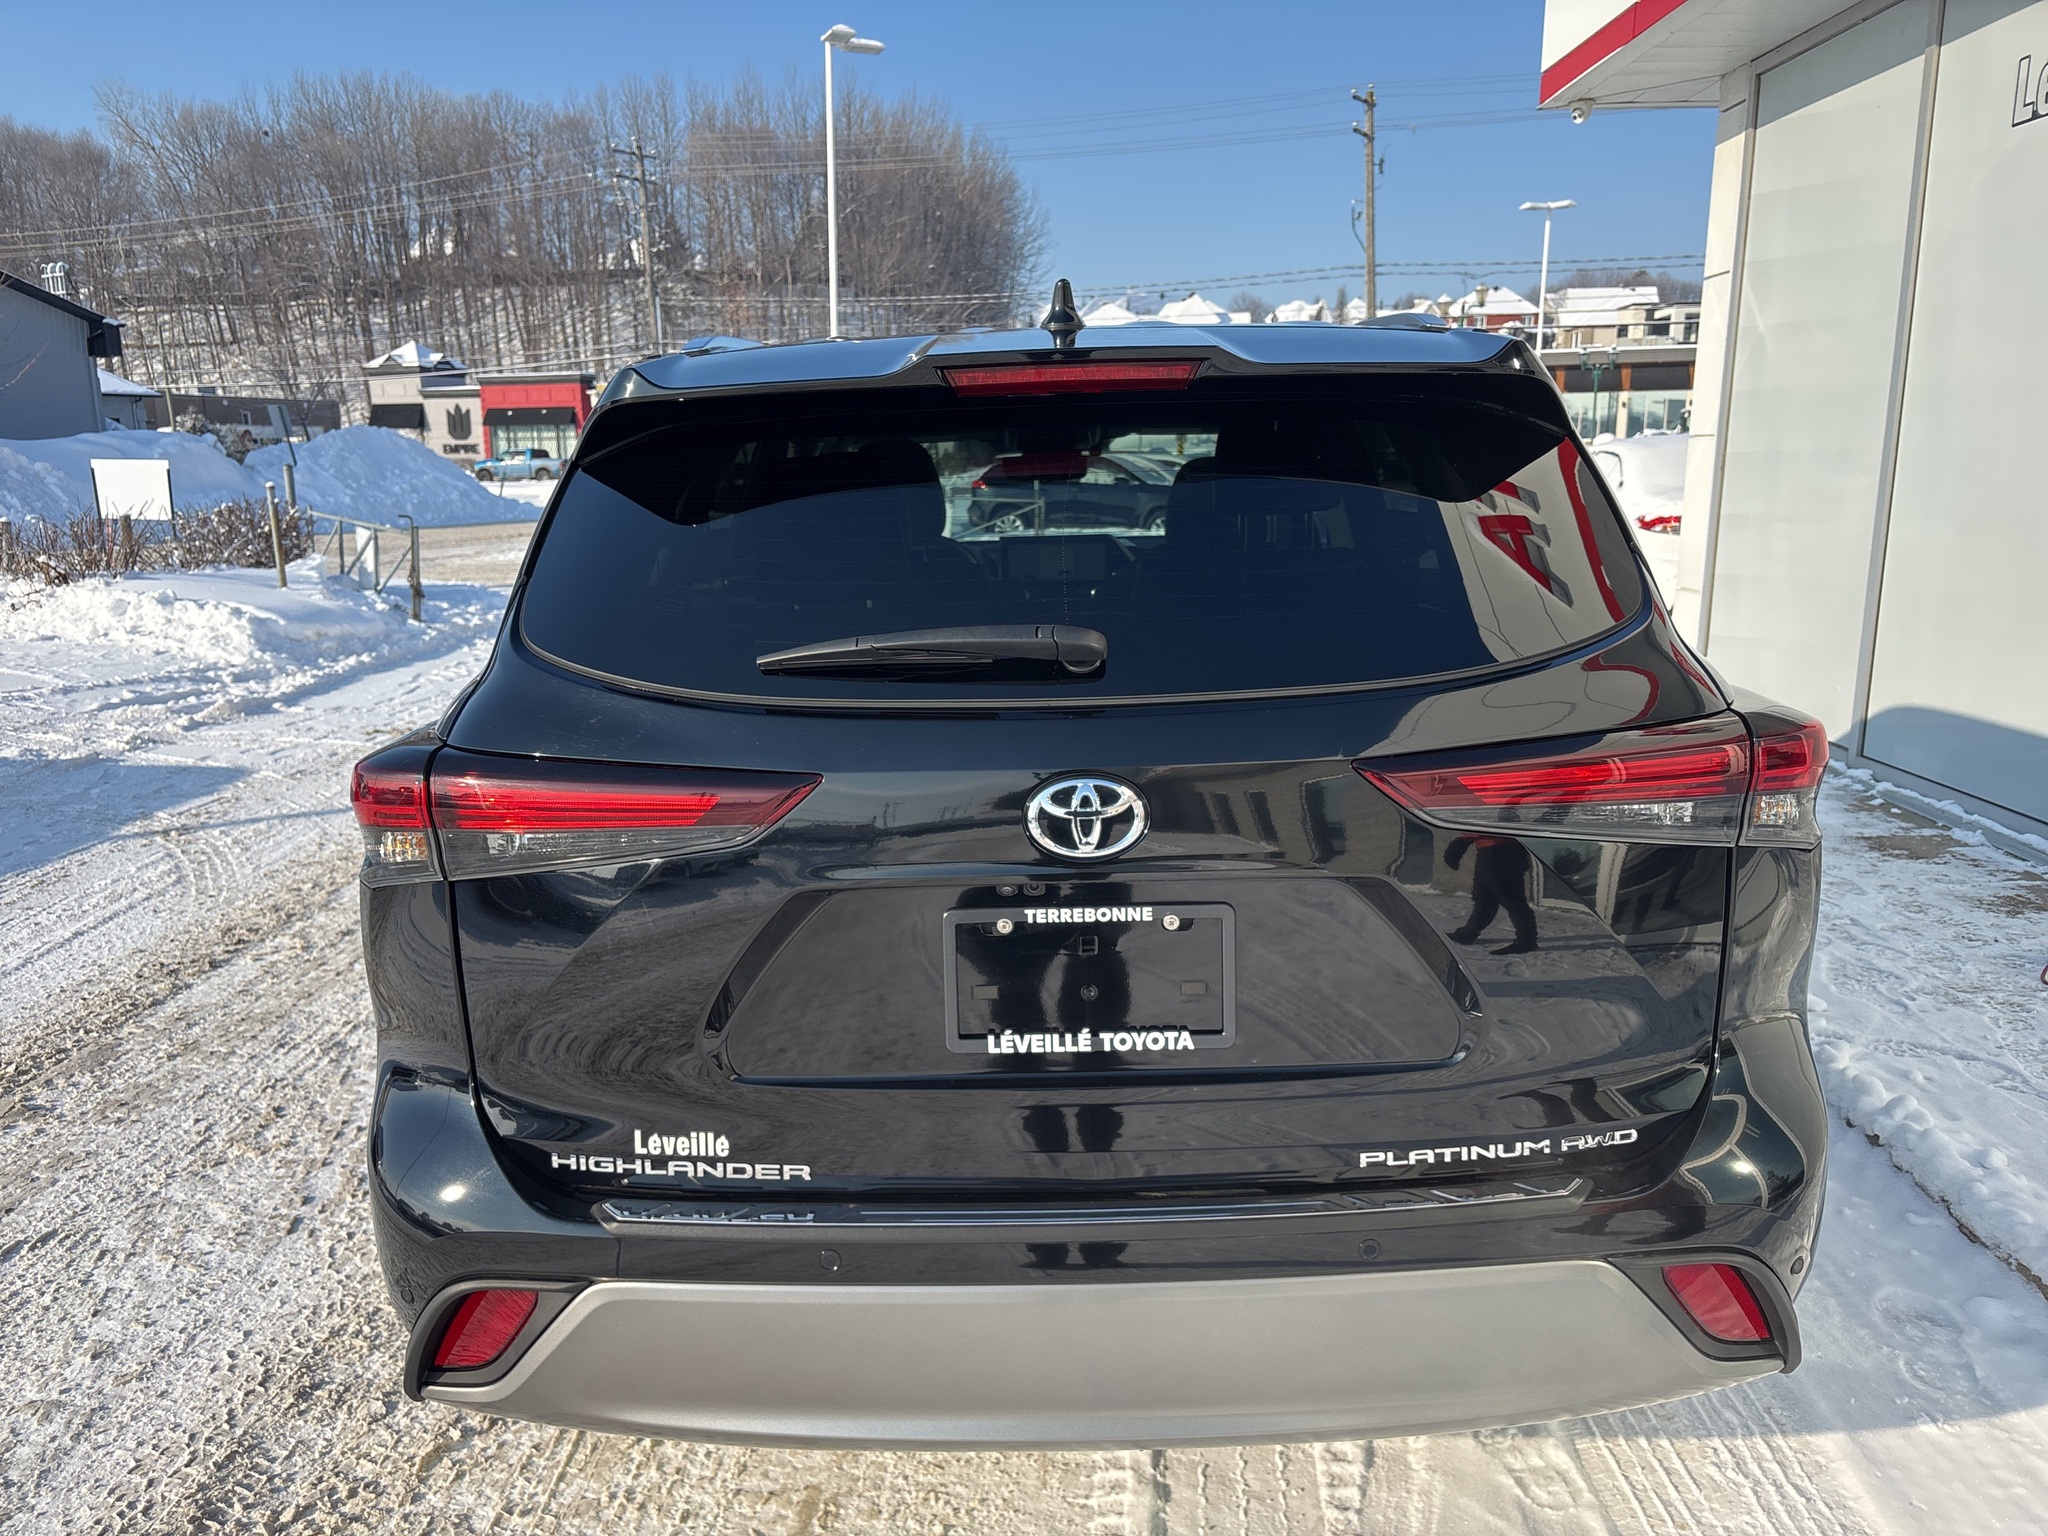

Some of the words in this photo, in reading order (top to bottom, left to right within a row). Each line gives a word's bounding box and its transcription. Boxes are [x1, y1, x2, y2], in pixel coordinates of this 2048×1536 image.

[443, 443, 480, 455] EMPIRE
[1024, 906, 1153, 924] TERREBONNE
[987, 1028, 1092, 1054] LÉVEILLÉ
[1099, 1030, 1195, 1052] TOYOTA
[1359, 1138, 1551, 1168] PLATINUM
[1561, 1128, 1638, 1152] AWD
[551, 1152, 812, 1181] HIGHLANDER
